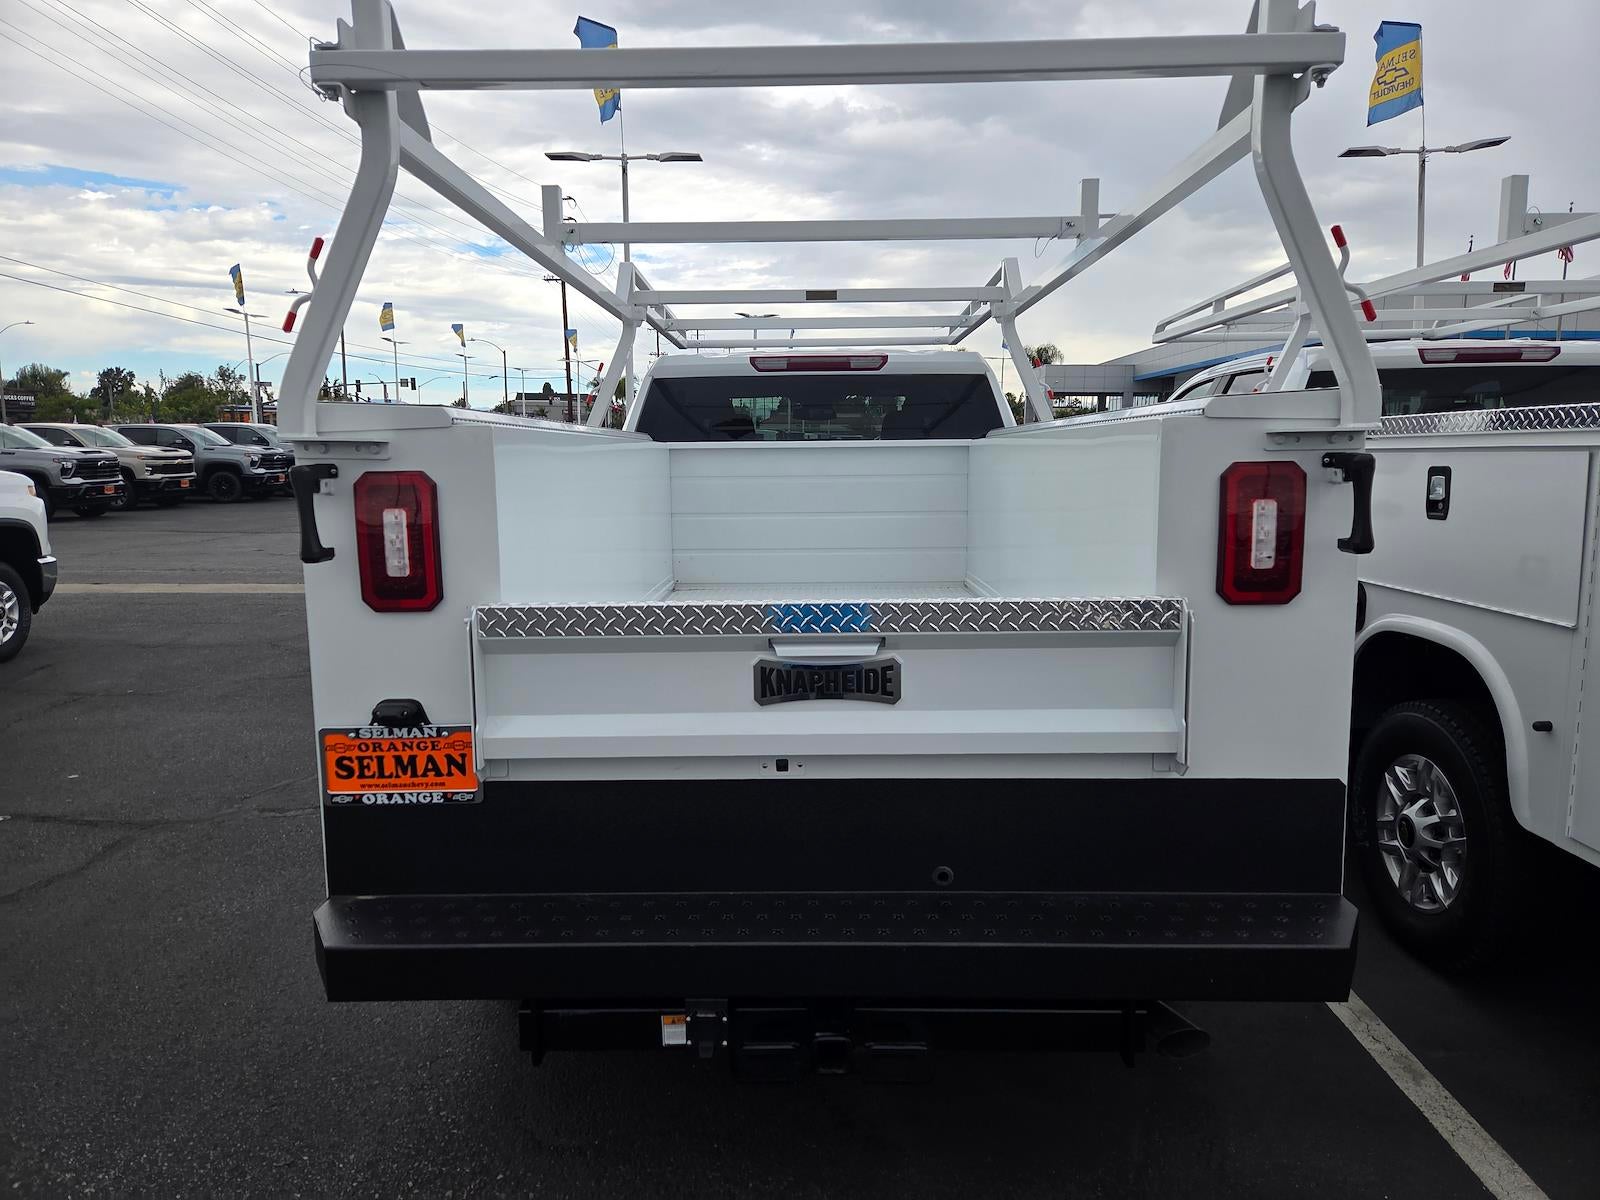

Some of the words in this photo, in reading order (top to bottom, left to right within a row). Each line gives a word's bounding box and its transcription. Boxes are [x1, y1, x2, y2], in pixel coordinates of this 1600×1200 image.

[760, 665, 894, 698] KNAPHEIDE
[359, 727, 438, 739] SELMAN
[357, 740, 442, 753] ORANGE
[335, 753, 468, 780] SELMAN
[359, 781, 446, 789] www.selmanchevy.com
[362, 792, 445, 805] ORANGE
